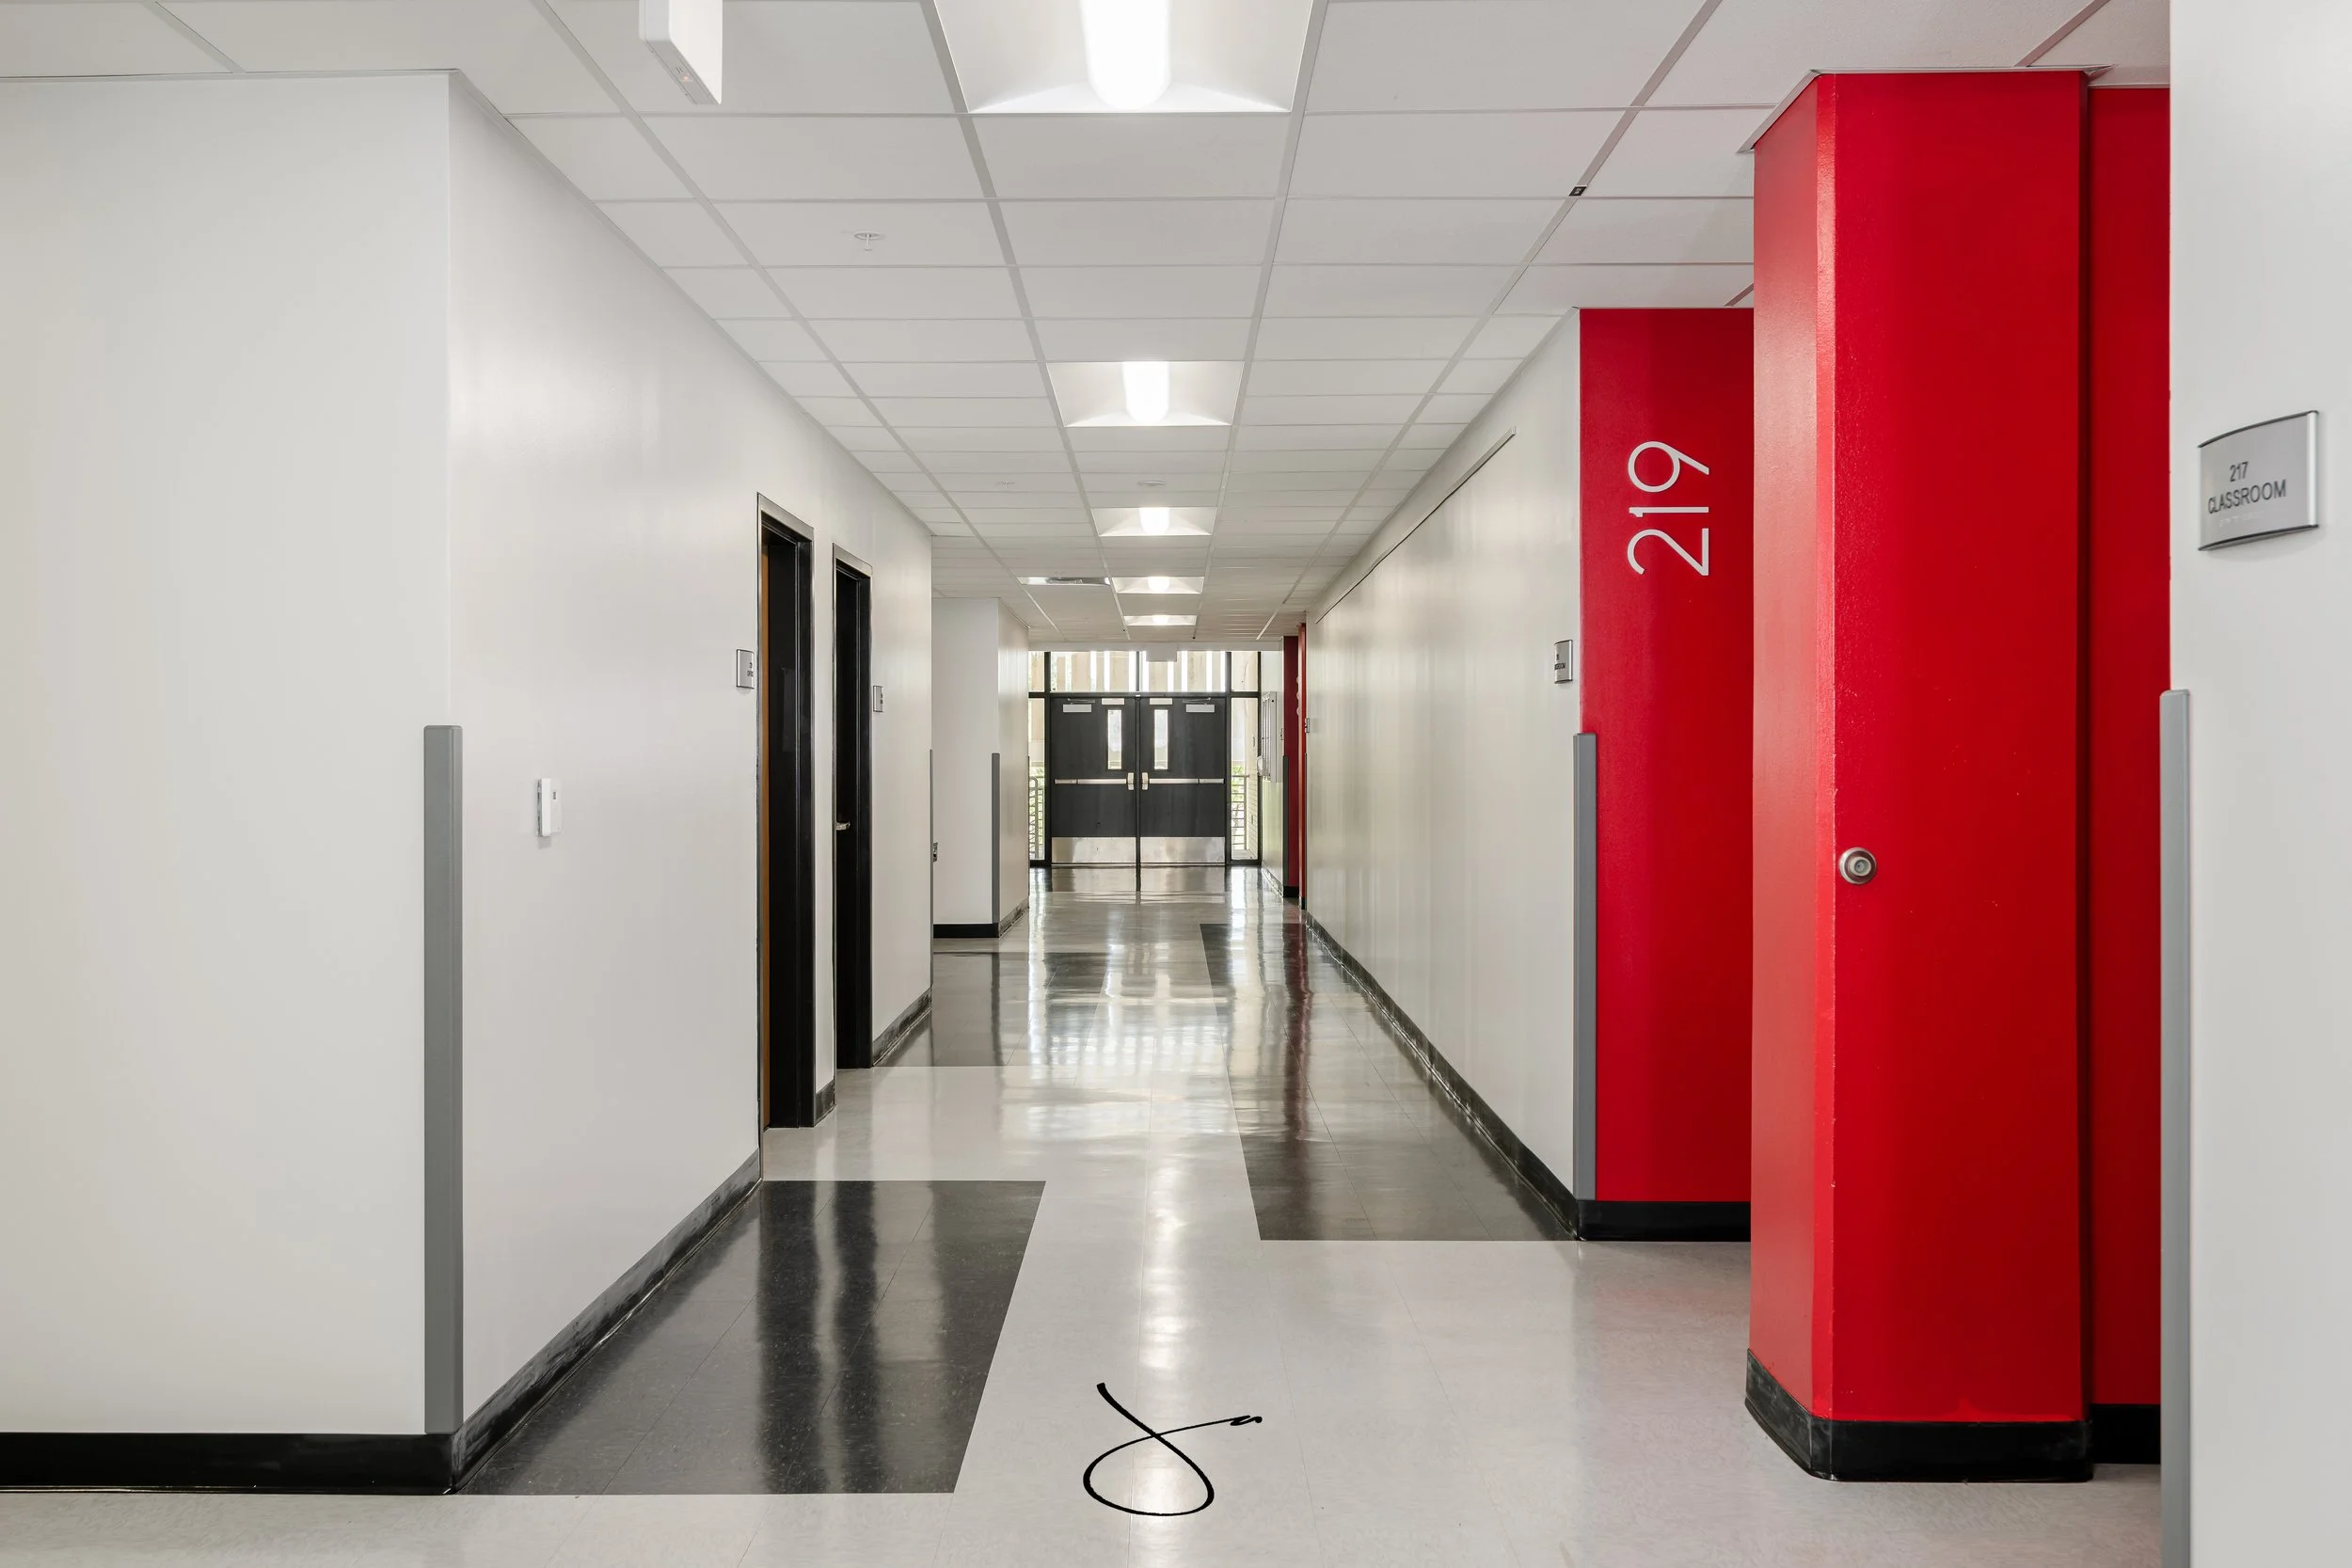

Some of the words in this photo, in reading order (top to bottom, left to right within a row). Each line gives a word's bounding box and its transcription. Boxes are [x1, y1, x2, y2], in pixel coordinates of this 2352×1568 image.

[2229, 461, 2249, 483] 217
[1627, 440, 1709, 576] 219
[2207, 479, 2286, 514] CLASSROOM
